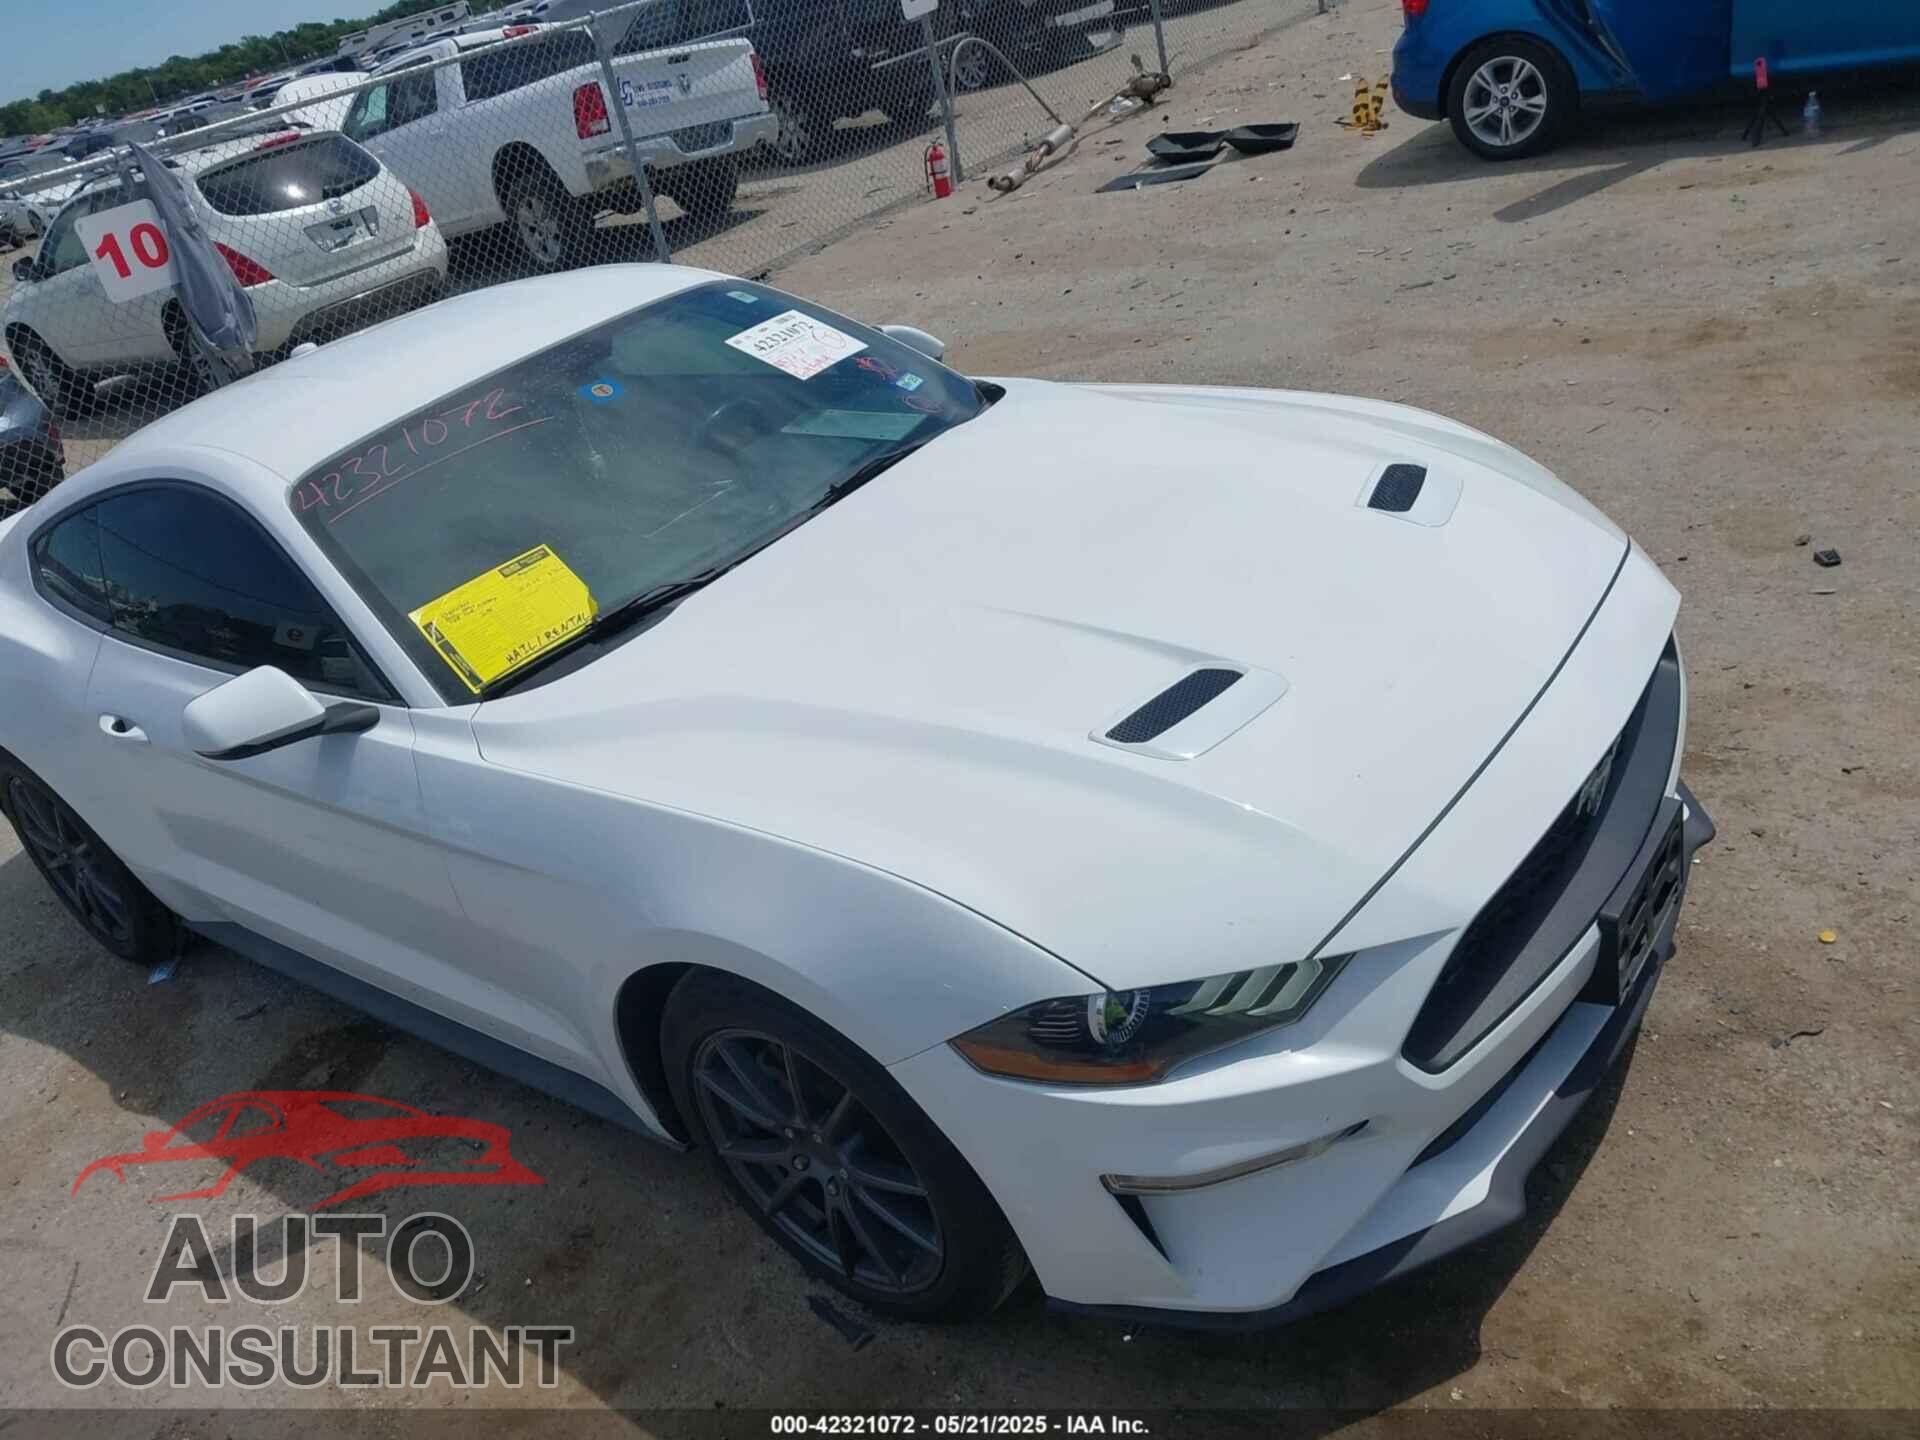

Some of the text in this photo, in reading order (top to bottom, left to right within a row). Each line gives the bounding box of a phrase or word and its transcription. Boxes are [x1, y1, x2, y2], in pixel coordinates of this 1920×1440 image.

[96, 222, 169, 278] 10
[753, 321, 814, 352] 42321072
[297, 388, 523, 511] 42321072
